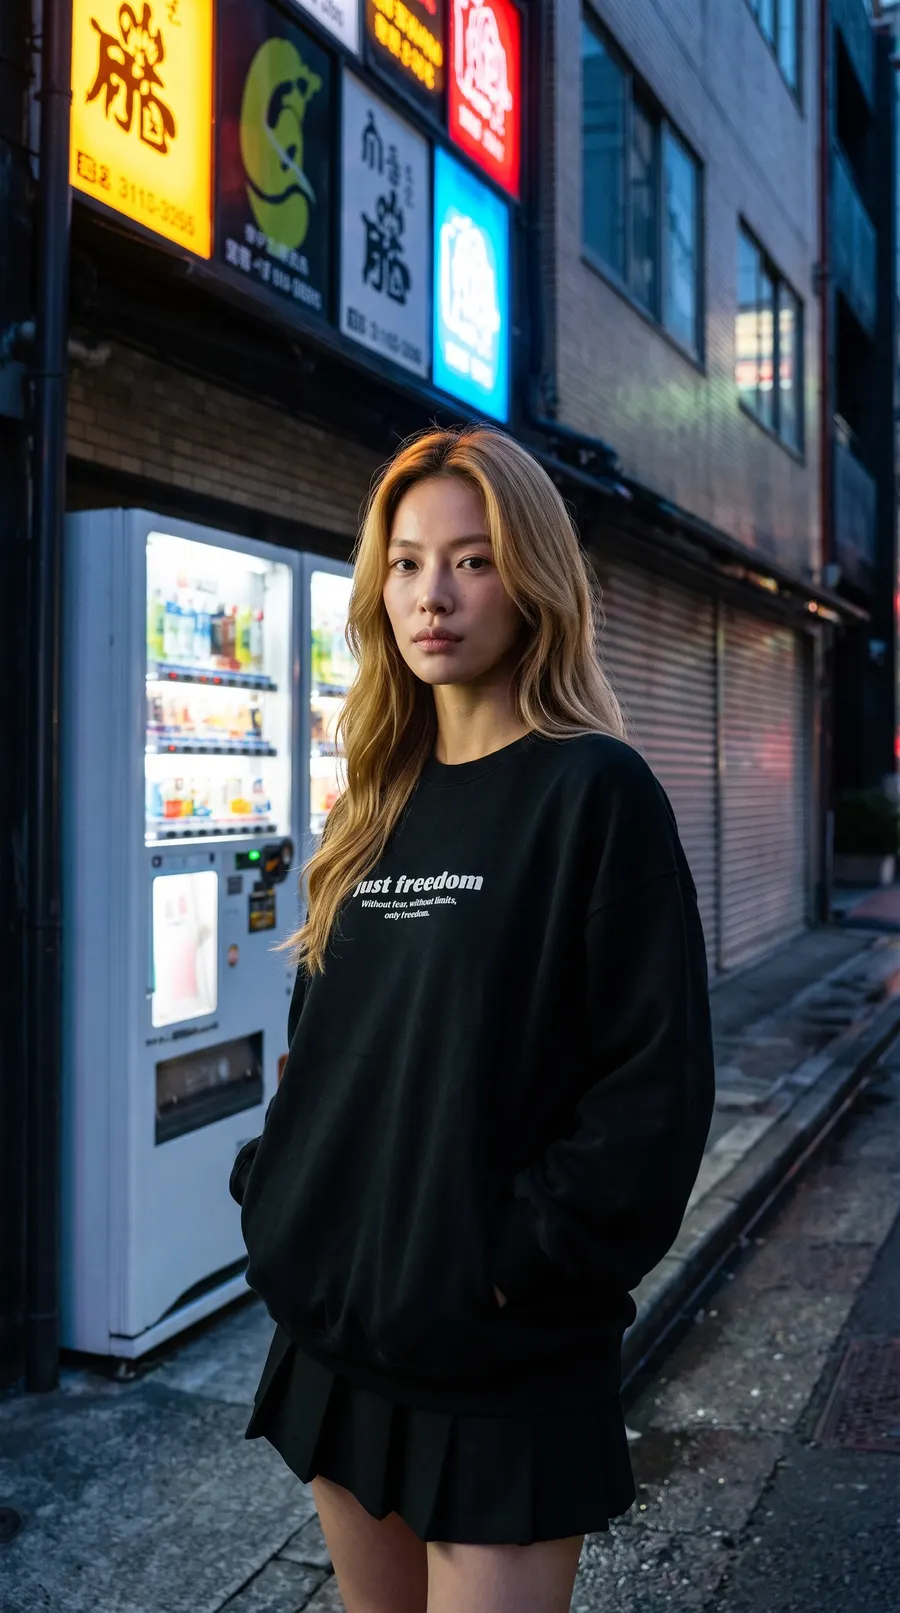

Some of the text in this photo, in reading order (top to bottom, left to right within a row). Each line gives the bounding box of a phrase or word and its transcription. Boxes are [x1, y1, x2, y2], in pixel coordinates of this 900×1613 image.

[353, 871, 483, 898] just freedom
[361, 896, 457, 909] Without fear, without limits,
[384, 909, 430, 921] only freedom.
